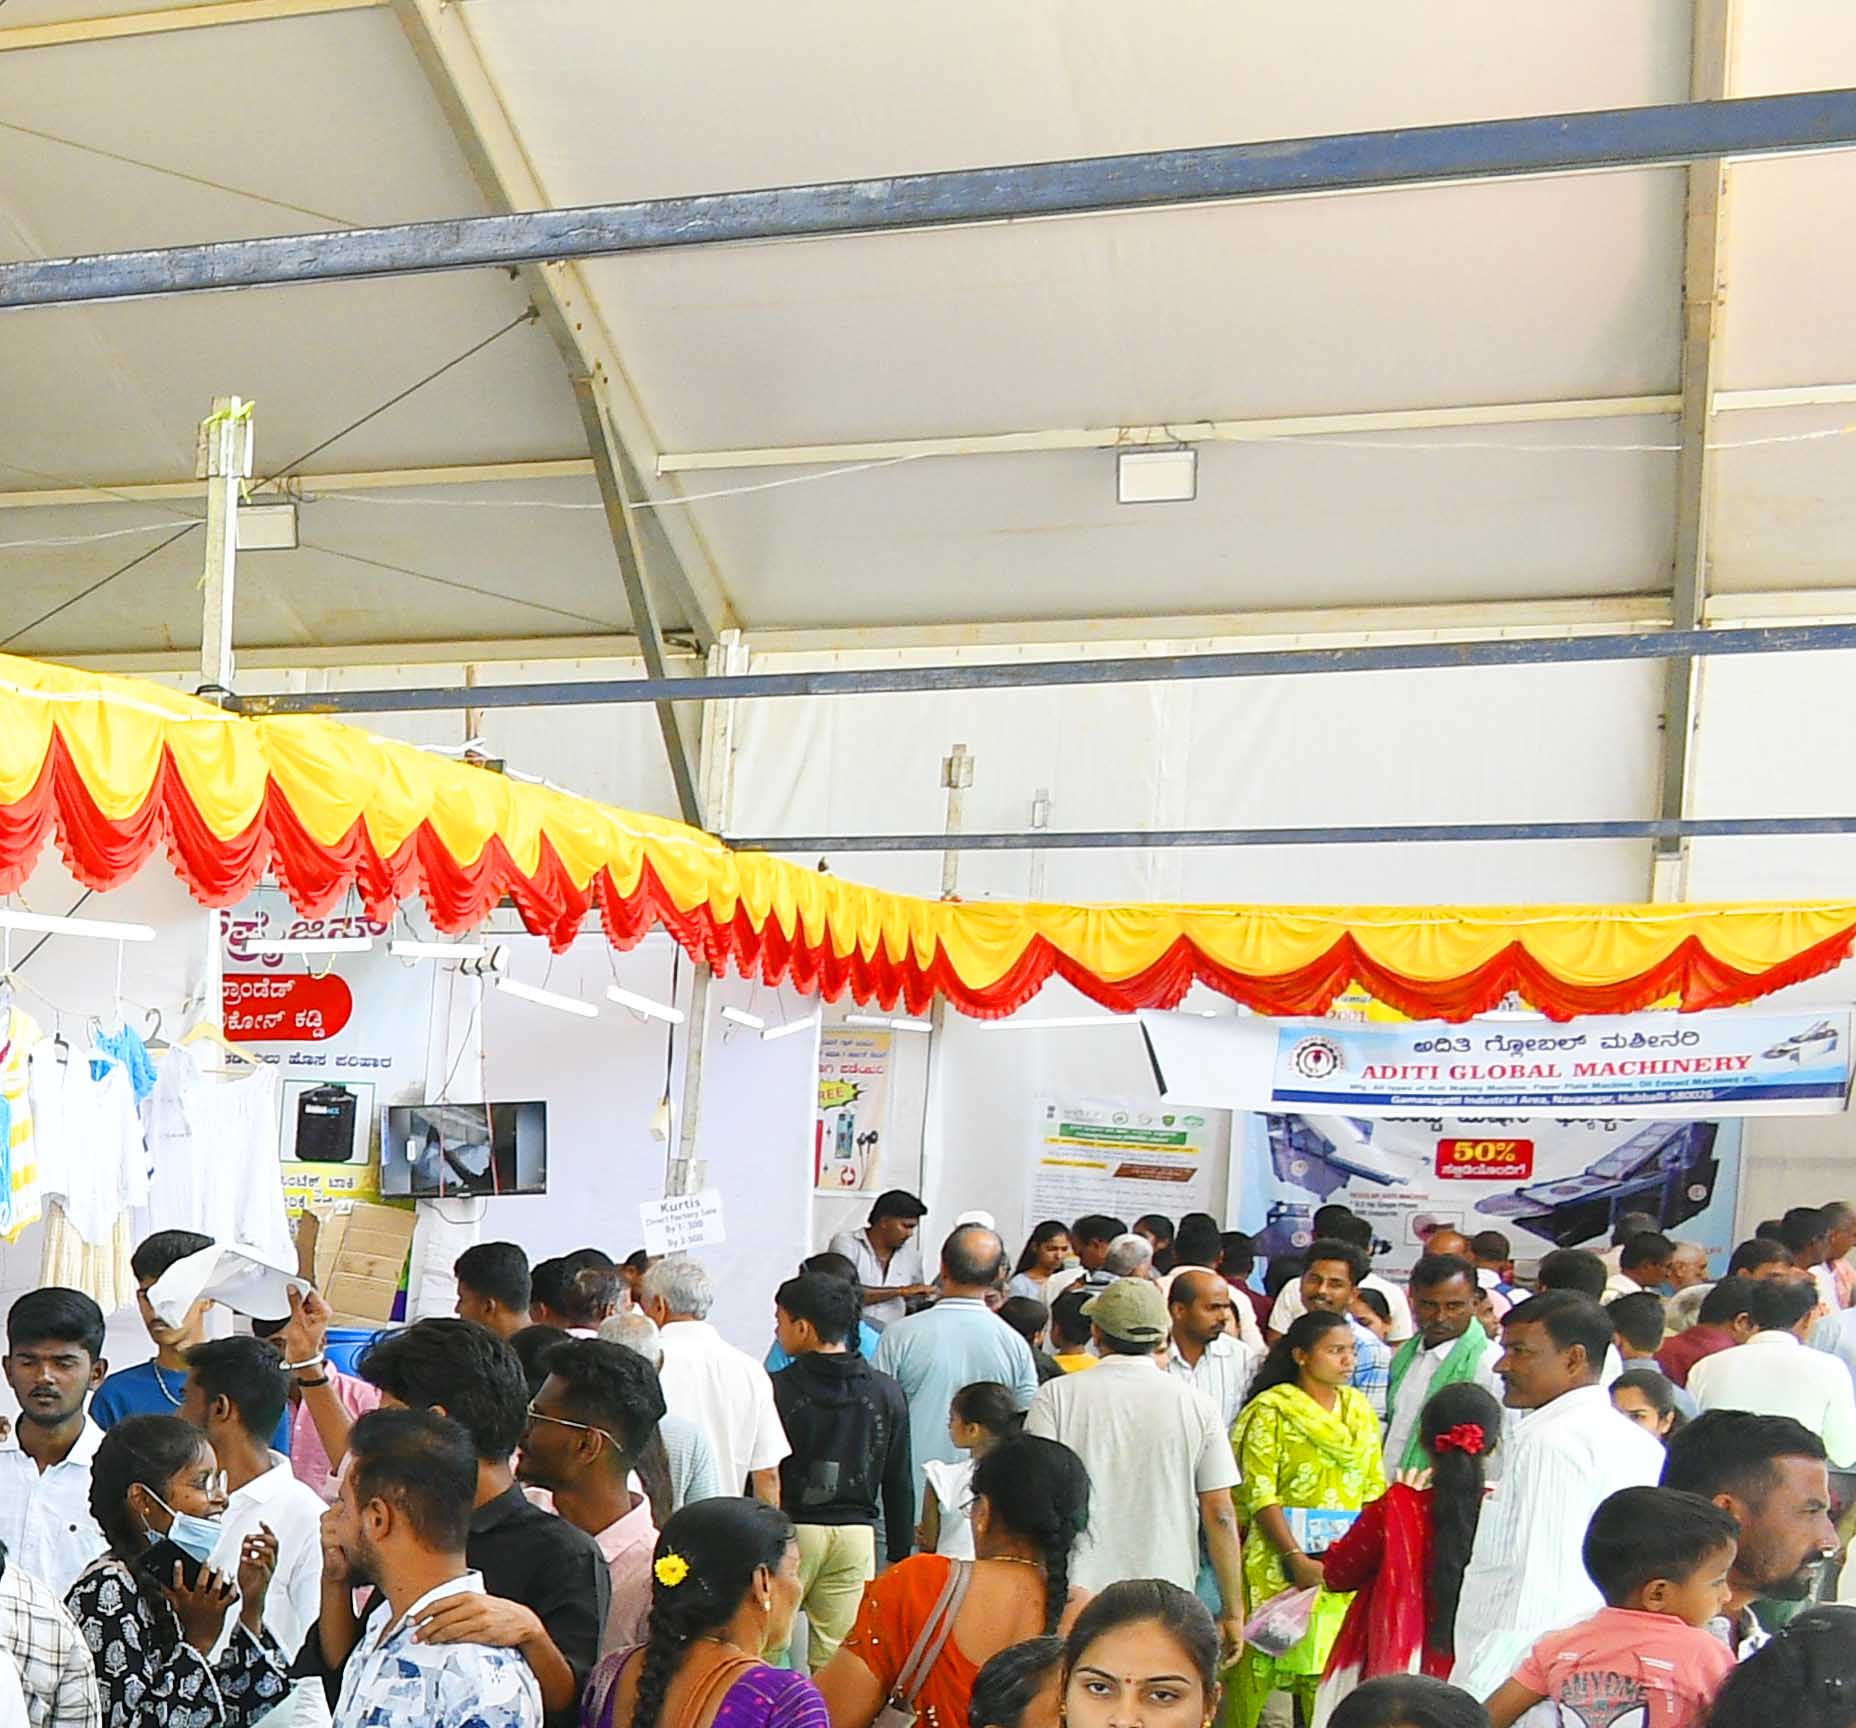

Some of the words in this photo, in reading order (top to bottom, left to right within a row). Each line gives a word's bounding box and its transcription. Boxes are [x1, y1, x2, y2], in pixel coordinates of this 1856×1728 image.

[1362, 1065, 1440, 1080] ADITI
[1449, 1064, 1561, 1080] GLOBAL
[1574, 1055, 1752, 1077] MACHINERY
[819, 1087, 844, 1101] REE
[1454, 1142, 1516, 1162] 50%
[659, 1199, 702, 1214] Kurtis
